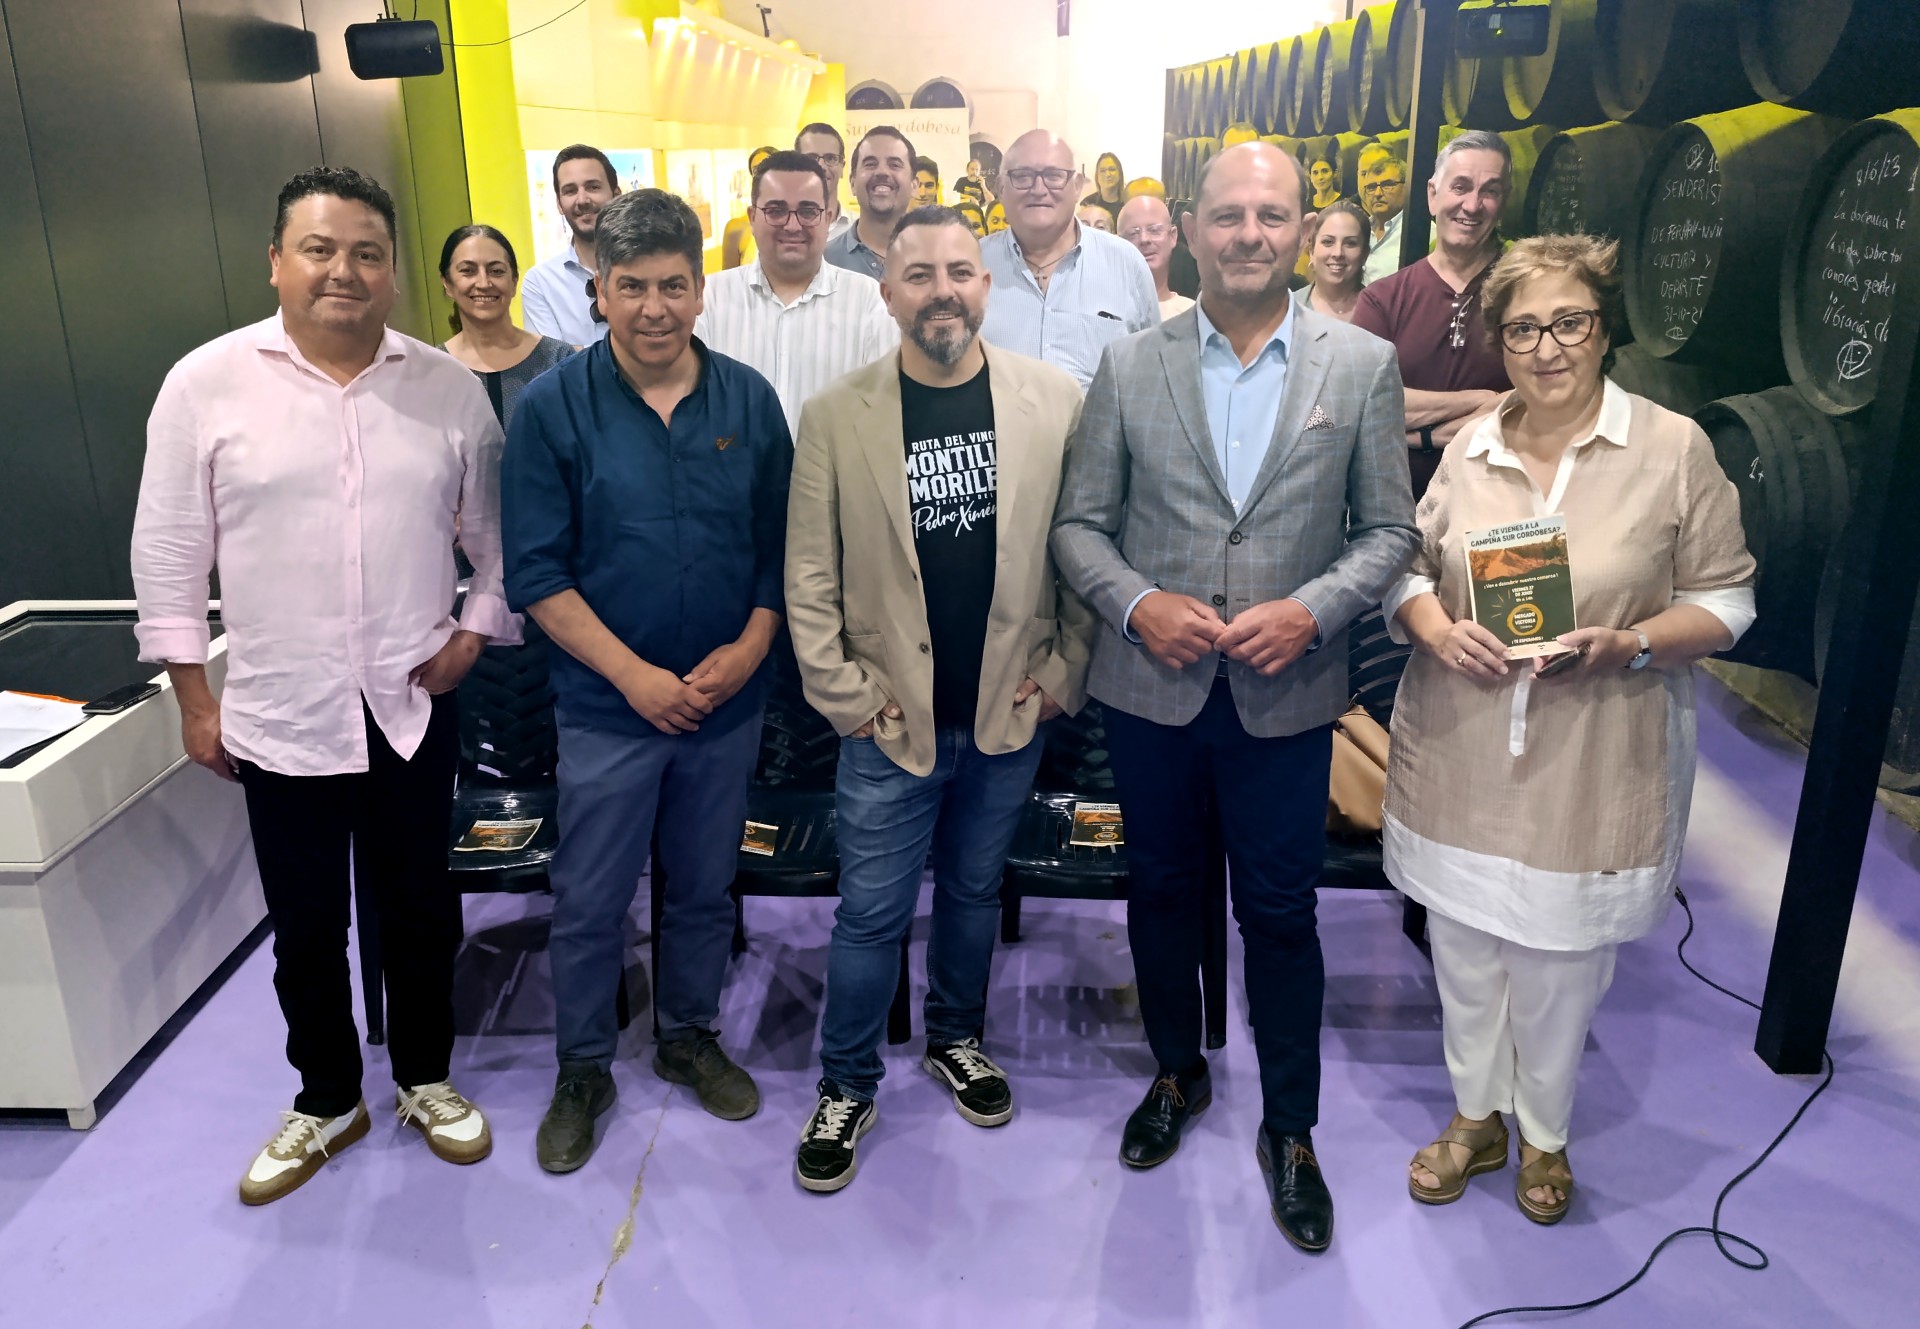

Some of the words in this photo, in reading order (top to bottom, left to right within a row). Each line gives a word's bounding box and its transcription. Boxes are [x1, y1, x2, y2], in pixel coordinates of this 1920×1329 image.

[894, 118, 961, 136] rdobesa
[911, 438, 941, 453] RUTA
[944, 434, 965, 448] DEL
[911, 505, 959, 539] Pedro
[1488, 529, 1499, 537] ¿TE
[1500, 524, 1524, 534] VIENES
[1531, 521, 1539, 529] LA
[1470, 535, 1501, 547] CAMPIÑA
[1502, 533, 1516, 542] SUR
[1516, 526, 1561, 540] CORDOBESA?
[1514, 611, 1536, 619] MERCADO
[1515, 618, 1536, 626] VICTORIA
